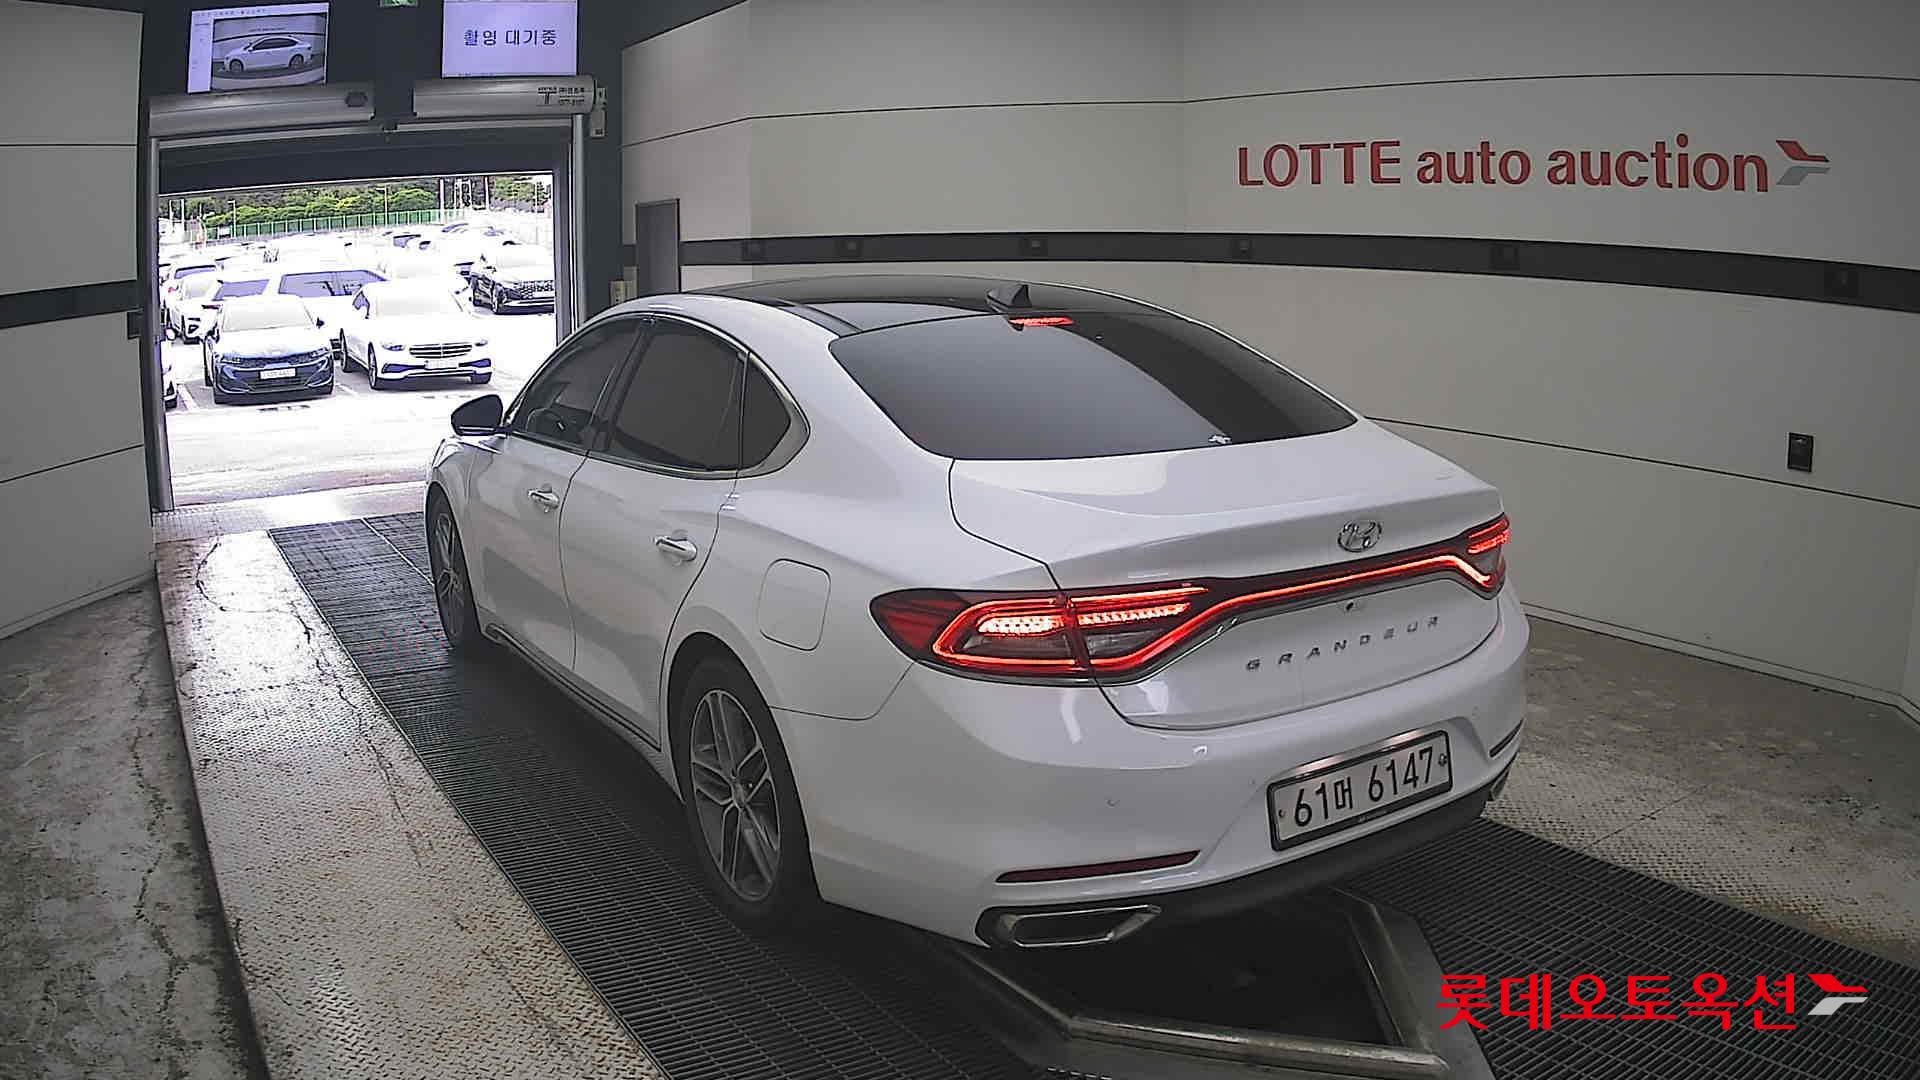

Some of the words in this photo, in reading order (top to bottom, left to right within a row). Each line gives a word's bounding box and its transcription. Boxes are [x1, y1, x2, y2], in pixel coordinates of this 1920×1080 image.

[505, 29, 557, 46] 대기중
[1239, 140, 1401, 187] LOTTE
[1416, 141, 1531, 185] auto
[1547, 133, 1769, 192] auction
[1246, 616, 1438, 671] GRANDEUR
[1294, 777, 1353, 827] 61머
[1368, 746, 1433, 802] 6147
